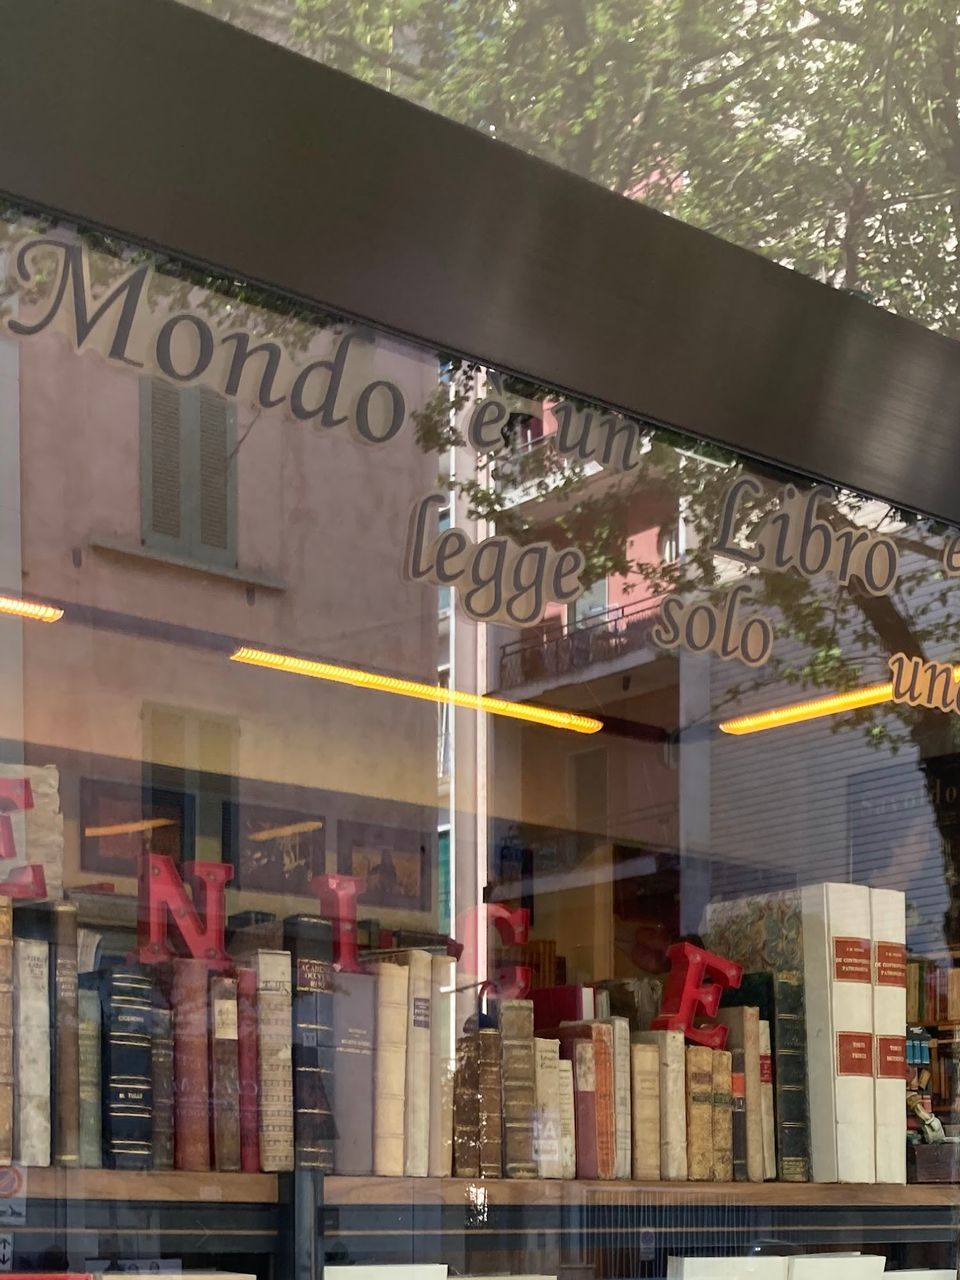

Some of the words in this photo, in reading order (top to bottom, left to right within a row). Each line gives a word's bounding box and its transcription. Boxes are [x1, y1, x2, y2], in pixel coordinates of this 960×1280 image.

[8, 238, 406, 444] Mondo
[555, 401, 640, 471] un
[713, 477, 897, 596] Libro
[411, 495, 583, 622] legge
[655, 587, 771, 663] solo
